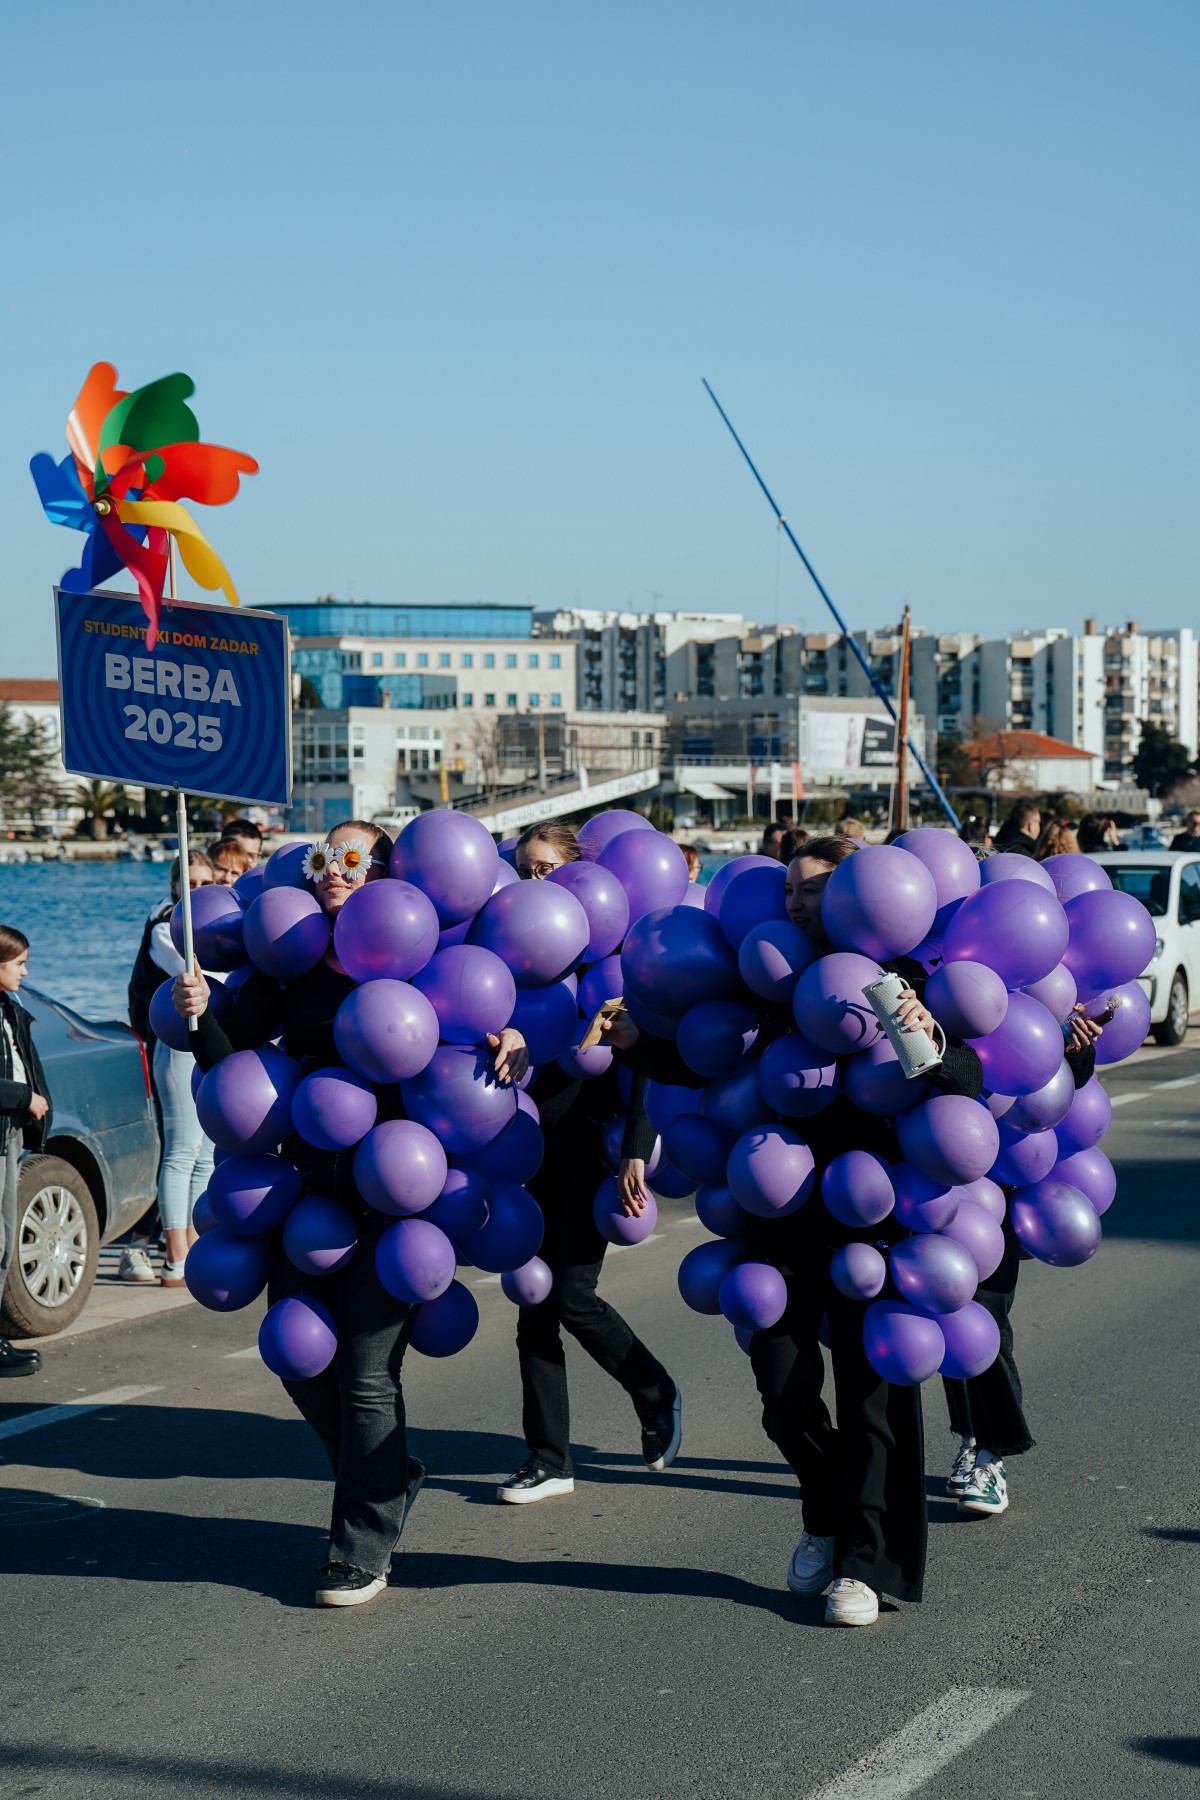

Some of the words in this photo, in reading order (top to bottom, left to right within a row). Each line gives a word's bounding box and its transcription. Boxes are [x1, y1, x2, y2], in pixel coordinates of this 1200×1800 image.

[83, 620, 169, 644] STUDENTKI
[172, 631, 207, 648] DOM
[210, 637, 259, 655] ZADAR
[105, 652, 242, 707] BERBA
[123, 704, 223, 752] 2025
